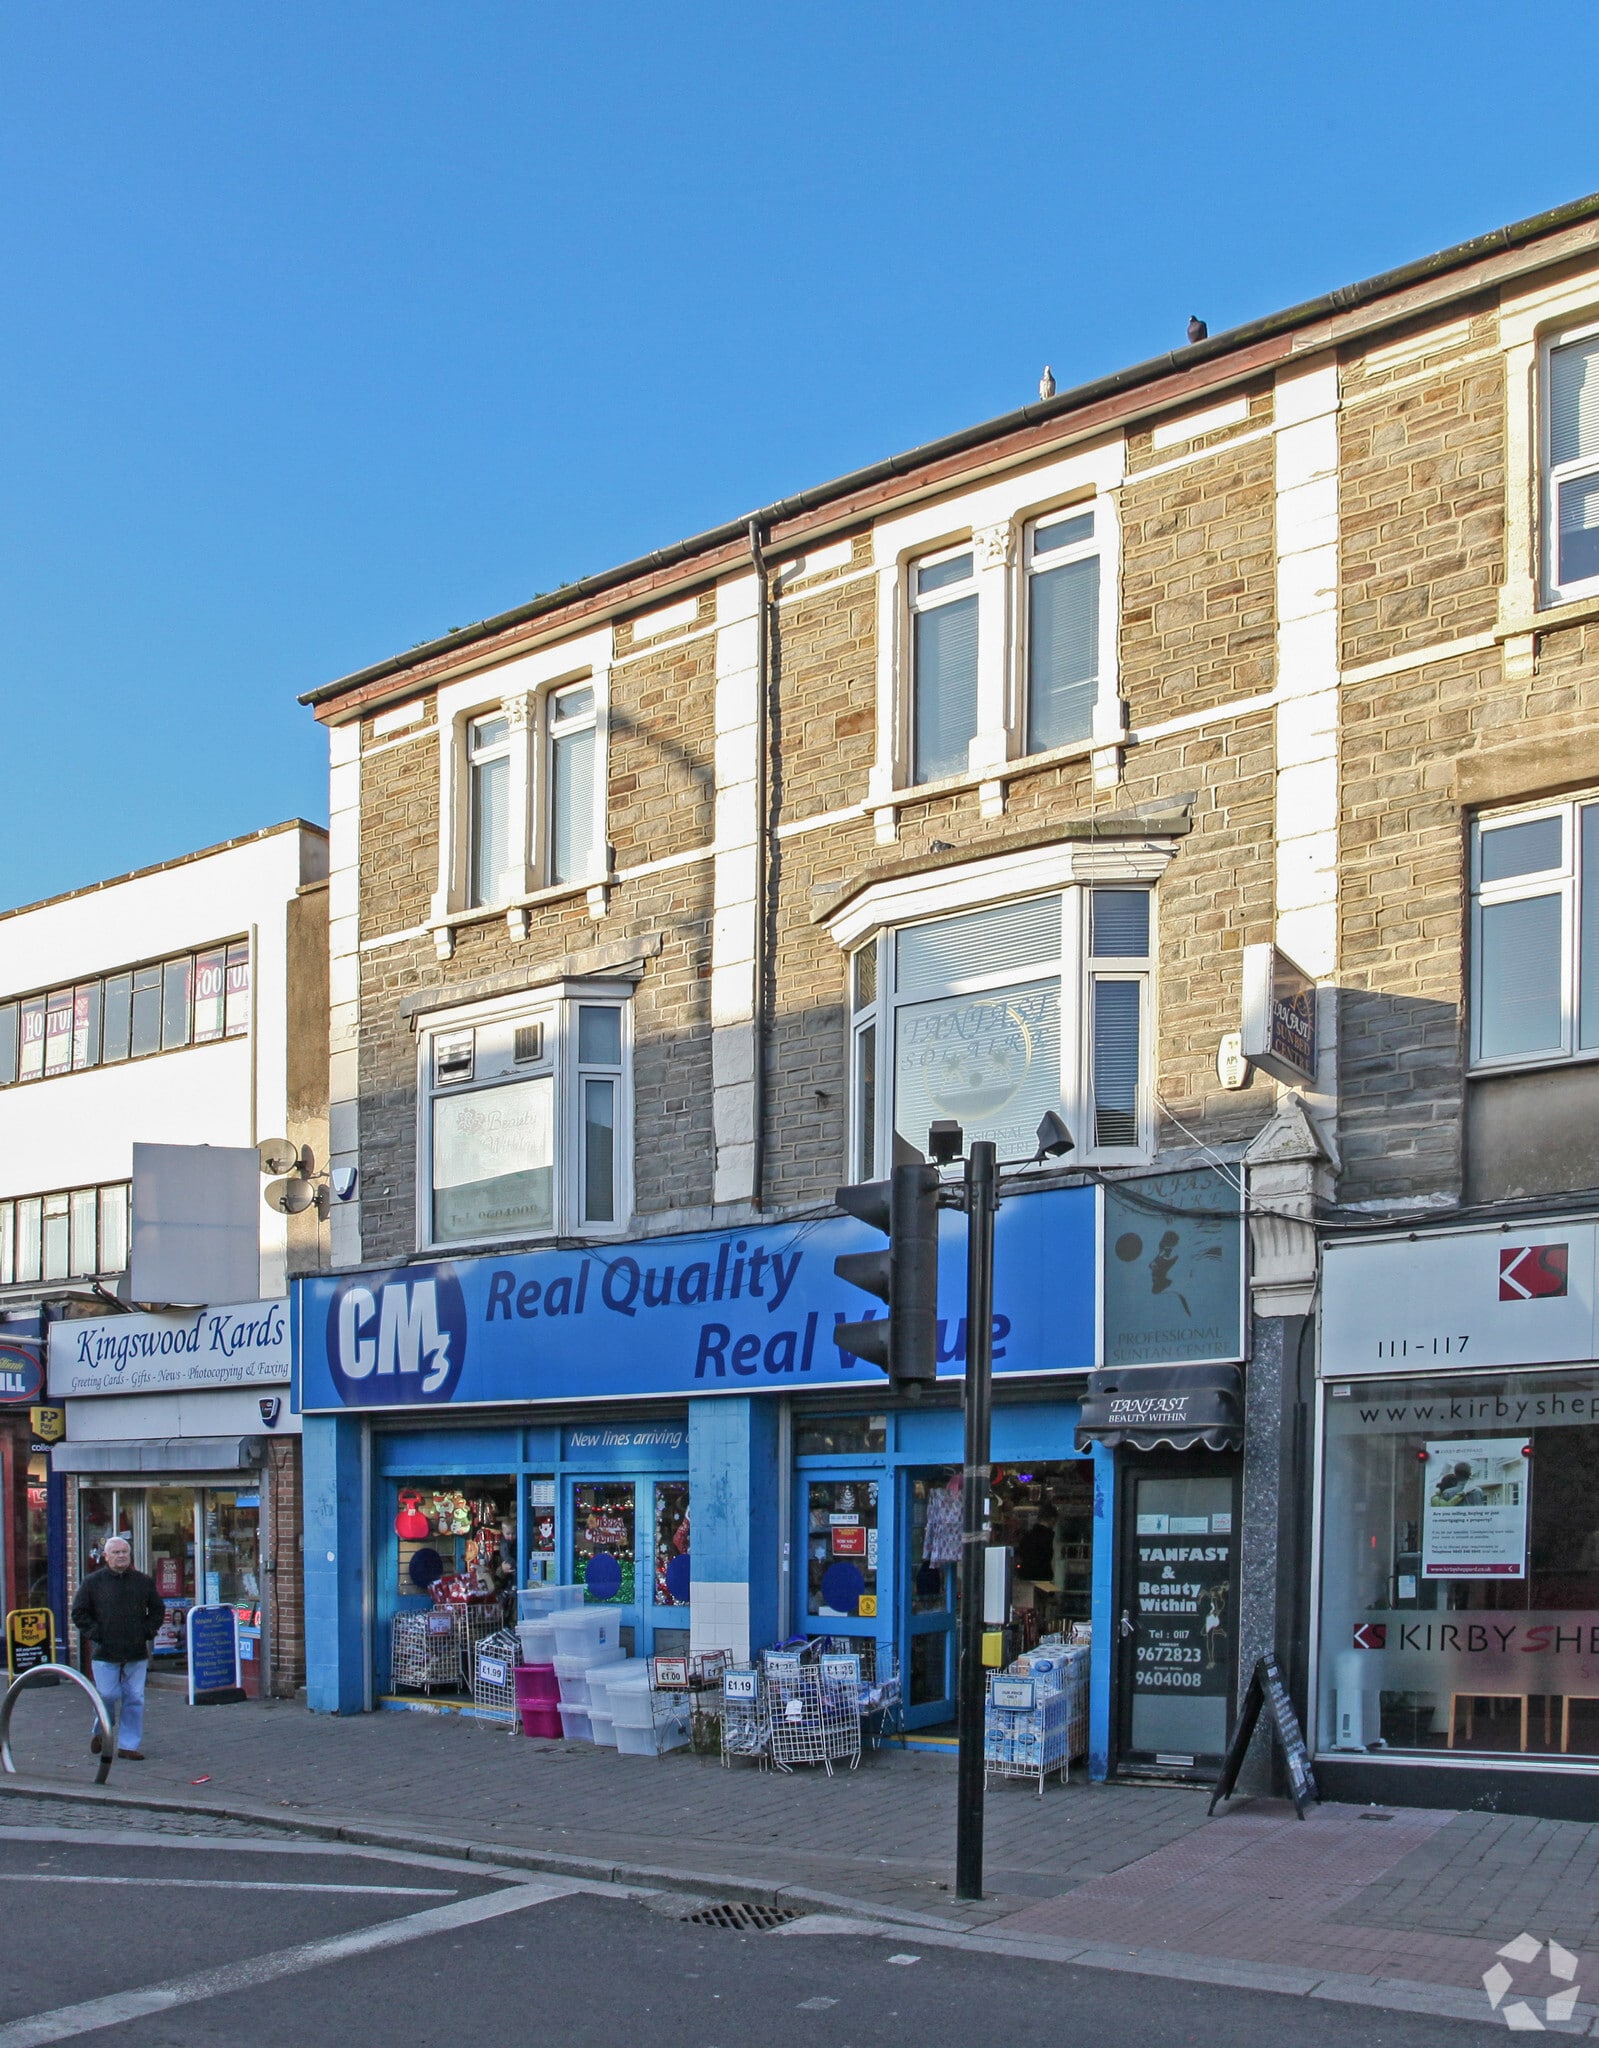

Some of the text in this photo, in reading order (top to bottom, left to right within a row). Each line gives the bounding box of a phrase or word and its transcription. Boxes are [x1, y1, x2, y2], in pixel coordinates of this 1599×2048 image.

[904, 994, 1056, 1045] TANFAST
[1272, 1000, 1309, 1038] TANFAST
[1275, 1022, 1311, 1056] SUNBED
[1275, 1040, 1311, 1072] CENTRE
[486, 1240, 804, 1321] Real Quality
[77, 1304, 286, 1372] Kingswood Kards
[1118, 1325, 1224, 1345] PROFESSIONAL
[694, 1312, 819, 1378] Real
[1113, 1341, 1232, 1361] SUNTAN CENTRE
[72, 1376, 102, 1393] Greeting
[103, 1371, 124, 1388] Cards
[131, 1370, 151, 1388] Gifts
[158, 1369, 181, 1382] News
[188, 1364, 243, 1384] Photocopying
[245, 1362, 256, 1377] &
[258, 1361, 289, 1378] Faxing
[1110, 1396, 1189, 1413] TANFAST
[1109, 1412, 1187, 1423] BEAUTY WITHIN
[40, 1428, 58, 1436] Point
[571, 1432, 600, 1447] New
[602, 1430, 630, 1446] lines
[633, 1429, 683, 1449] arriving
[1139, 1547, 1229, 1562] TANFAST
[1161, 1566, 1176, 1579] &
[1138, 1582, 1201, 1598] Beauty
[1139, 1598, 1198, 1612] Within
[1148, 1629, 1163, 1639] Tel
[1173, 1630, 1190, 1639] 0117
[1137, 1647, 1202, 1662] 9672823
[482, 1665, 502, 1678] £1.99
[661, 1672, 681, 1681] £1.00
[1136, 1671, 1202, 1687] 9604008
[728, 1680, 752, 1691] £1.19
